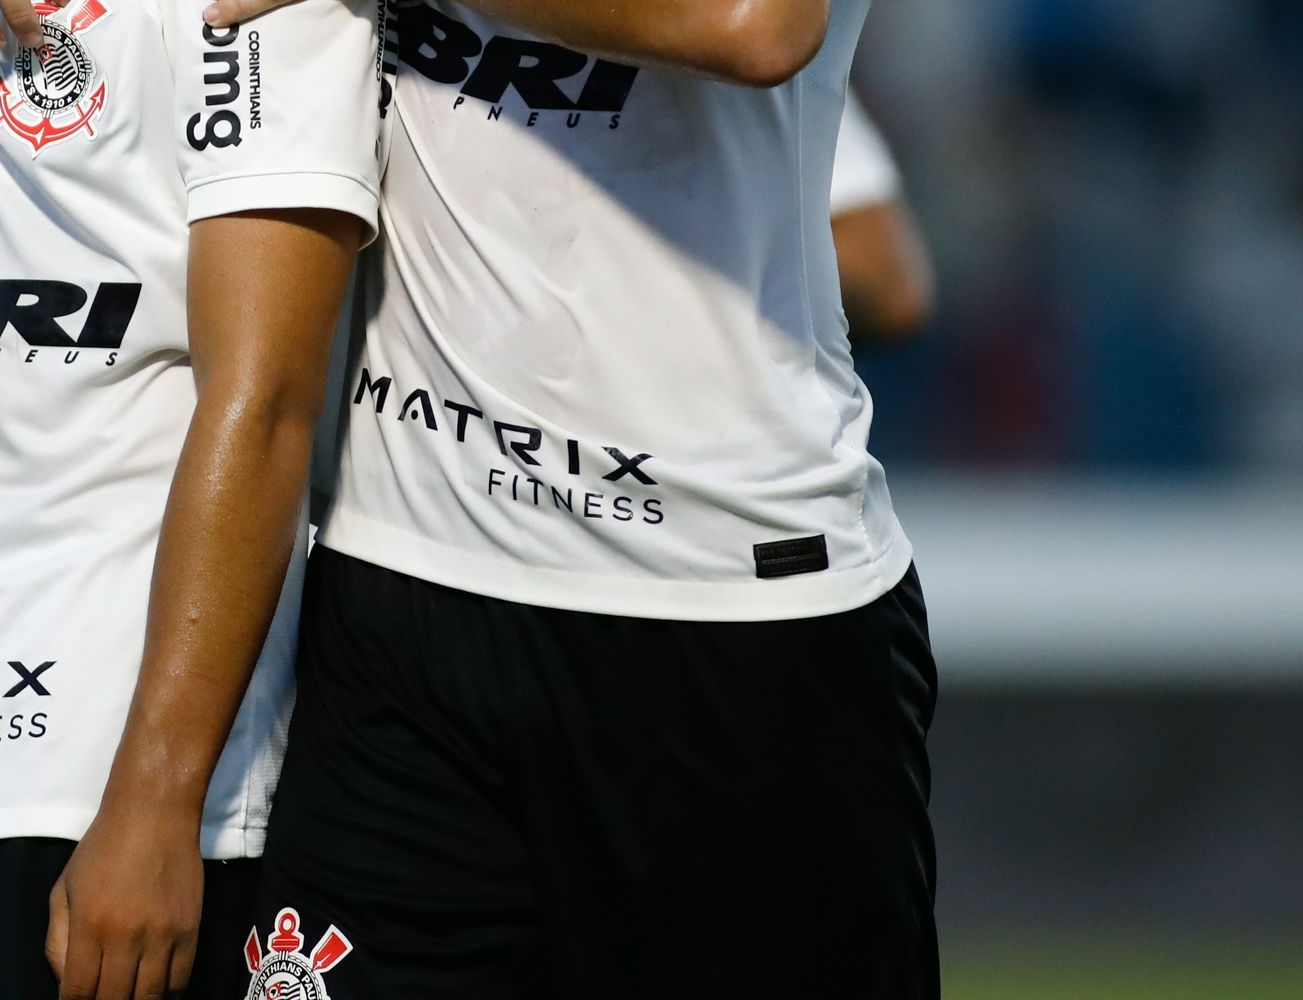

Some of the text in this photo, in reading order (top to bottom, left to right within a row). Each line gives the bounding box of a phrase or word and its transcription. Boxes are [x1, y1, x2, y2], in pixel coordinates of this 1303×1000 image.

[63, 37, 87, 95] PAULISTA
[247, 30, 262, 130] CORINTHIANS
[40, 98, 65, 109] 1910
[453, 96, 621, 130] PNEUS
[353, 367, 659, 486] MATRIX
[487, 468, 665, 526] FITNESS
[252, 961, 302, 1000] ORINTHIANS
